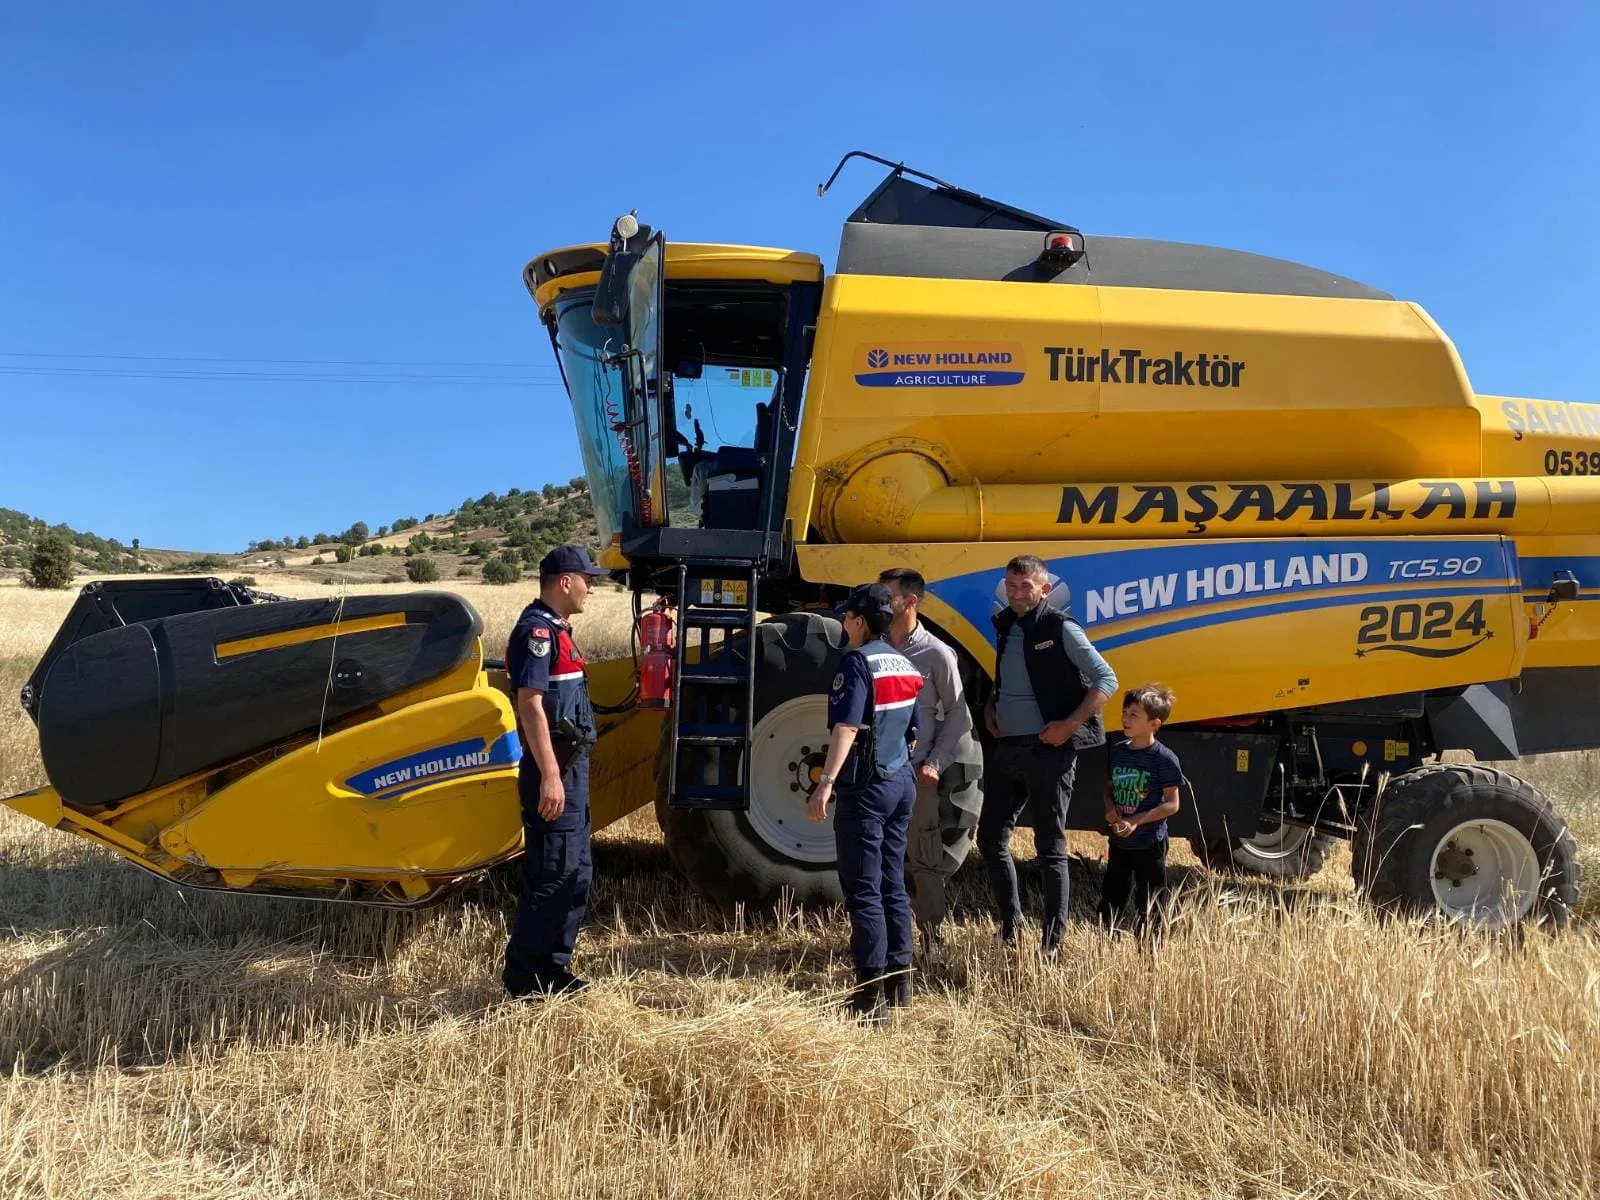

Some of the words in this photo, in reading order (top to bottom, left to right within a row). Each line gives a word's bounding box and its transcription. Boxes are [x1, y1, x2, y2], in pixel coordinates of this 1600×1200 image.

[893, 353, 932, 366] NEW
[935, 352, 1013, 365] HOLLAND
[1043, 346, 1246, 388] TürkTraktör
[895, 375, 987, 386] AGRICULTURE
[1544, 449, 1600, 477] 0539
[1055, 480, 1517, 534] MAŞAALLAH
[1085, 572, 1179, 623] NEW
[1186, 552, 1369, 602] HOLLAND
[1388, 556, 1483, 580] TC5.90
[1356, 599, 1487, 645] 2024
[373, 766, 412, 790] NEW
[414, 751, 491, 778] HOLLAND
